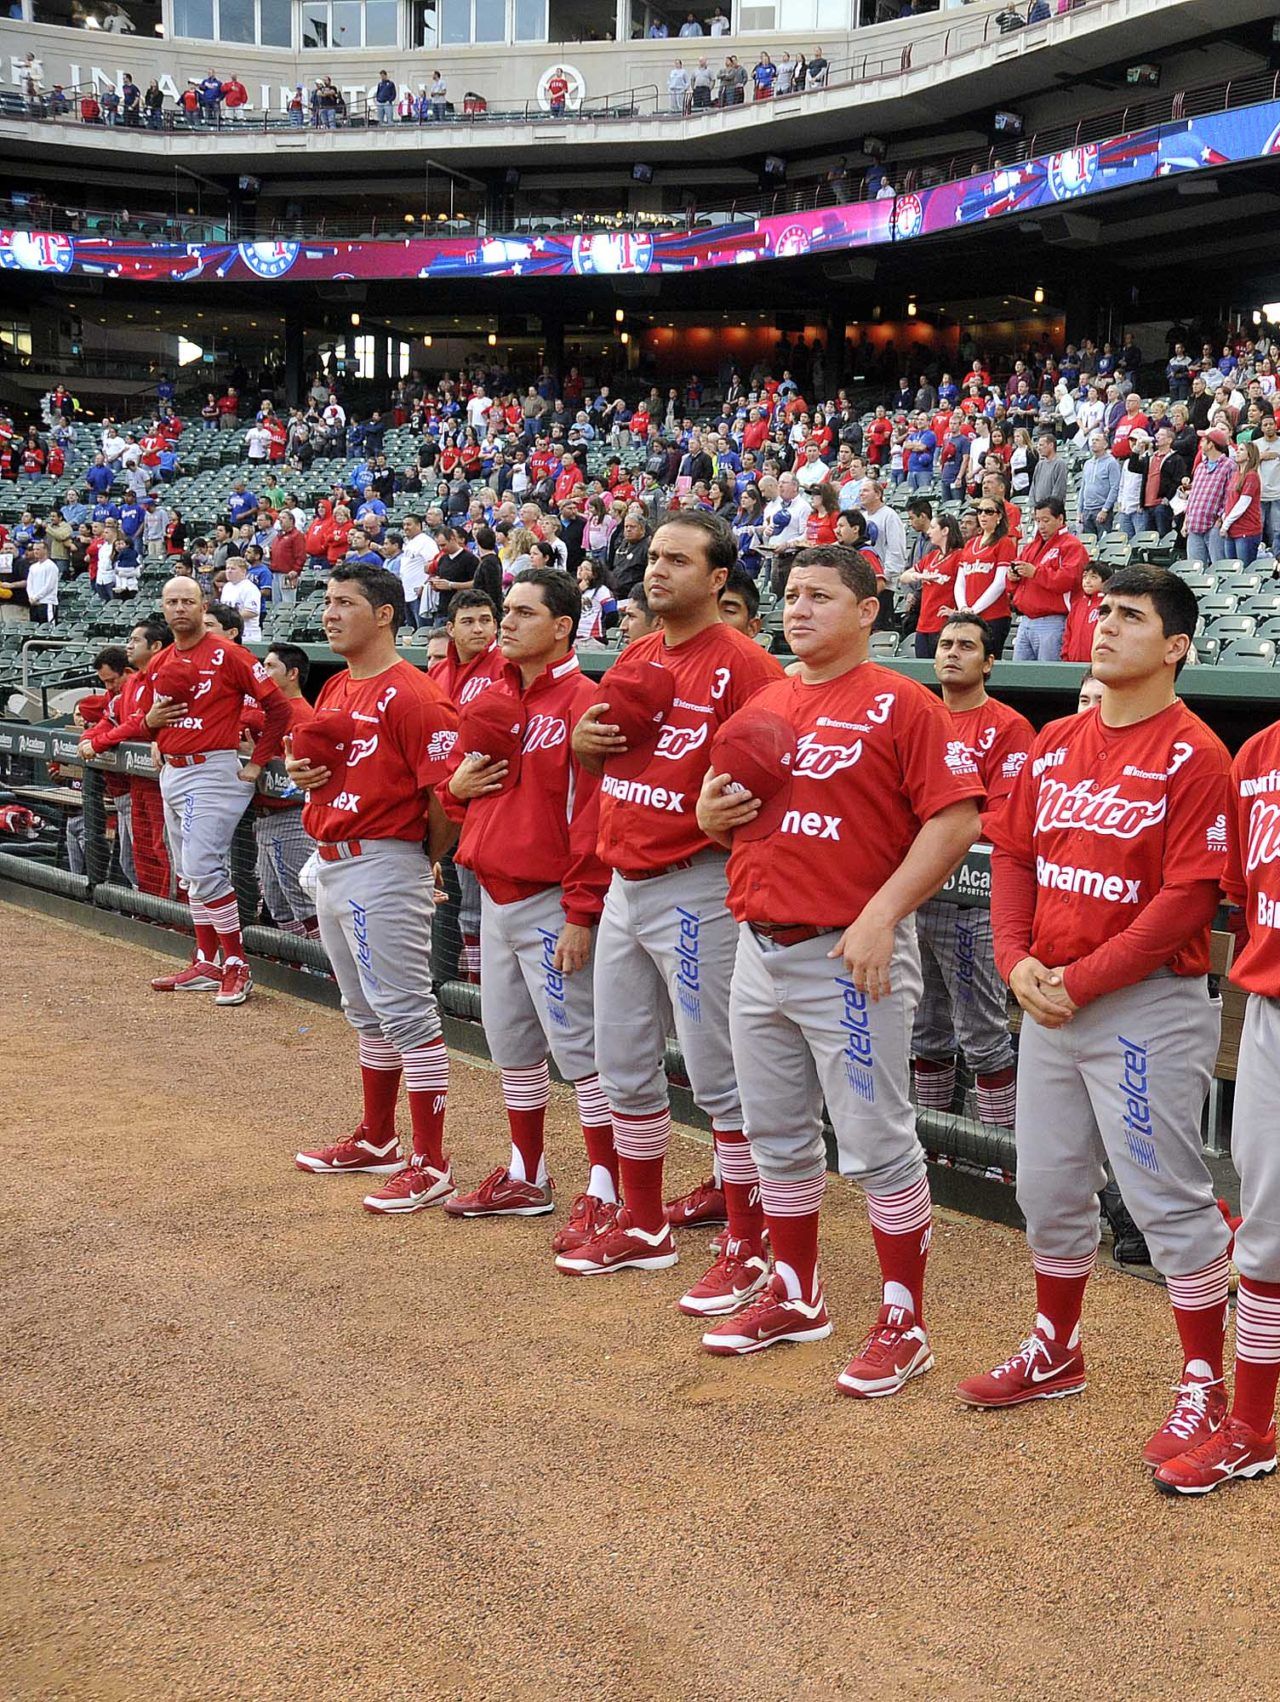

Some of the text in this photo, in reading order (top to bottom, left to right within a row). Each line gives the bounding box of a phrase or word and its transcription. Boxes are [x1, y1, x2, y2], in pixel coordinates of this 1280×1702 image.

[211, 648, 225, 666] 3
[376, 686, 398, 713] 3
[711, 667, 731, 699] 3
[866, 693, 896, 724] 3
[979, 727, 997, 750] 3
[1165, 742, 1194, 776] 3
[349, 900, 369, 970] telcel
[673, 906, 700, 992] telcel
[537, 927, 564, 1002] telcel
[834, 976, 874, 1068] telcel
[1117, 1035, 1153, 1136] telcel
